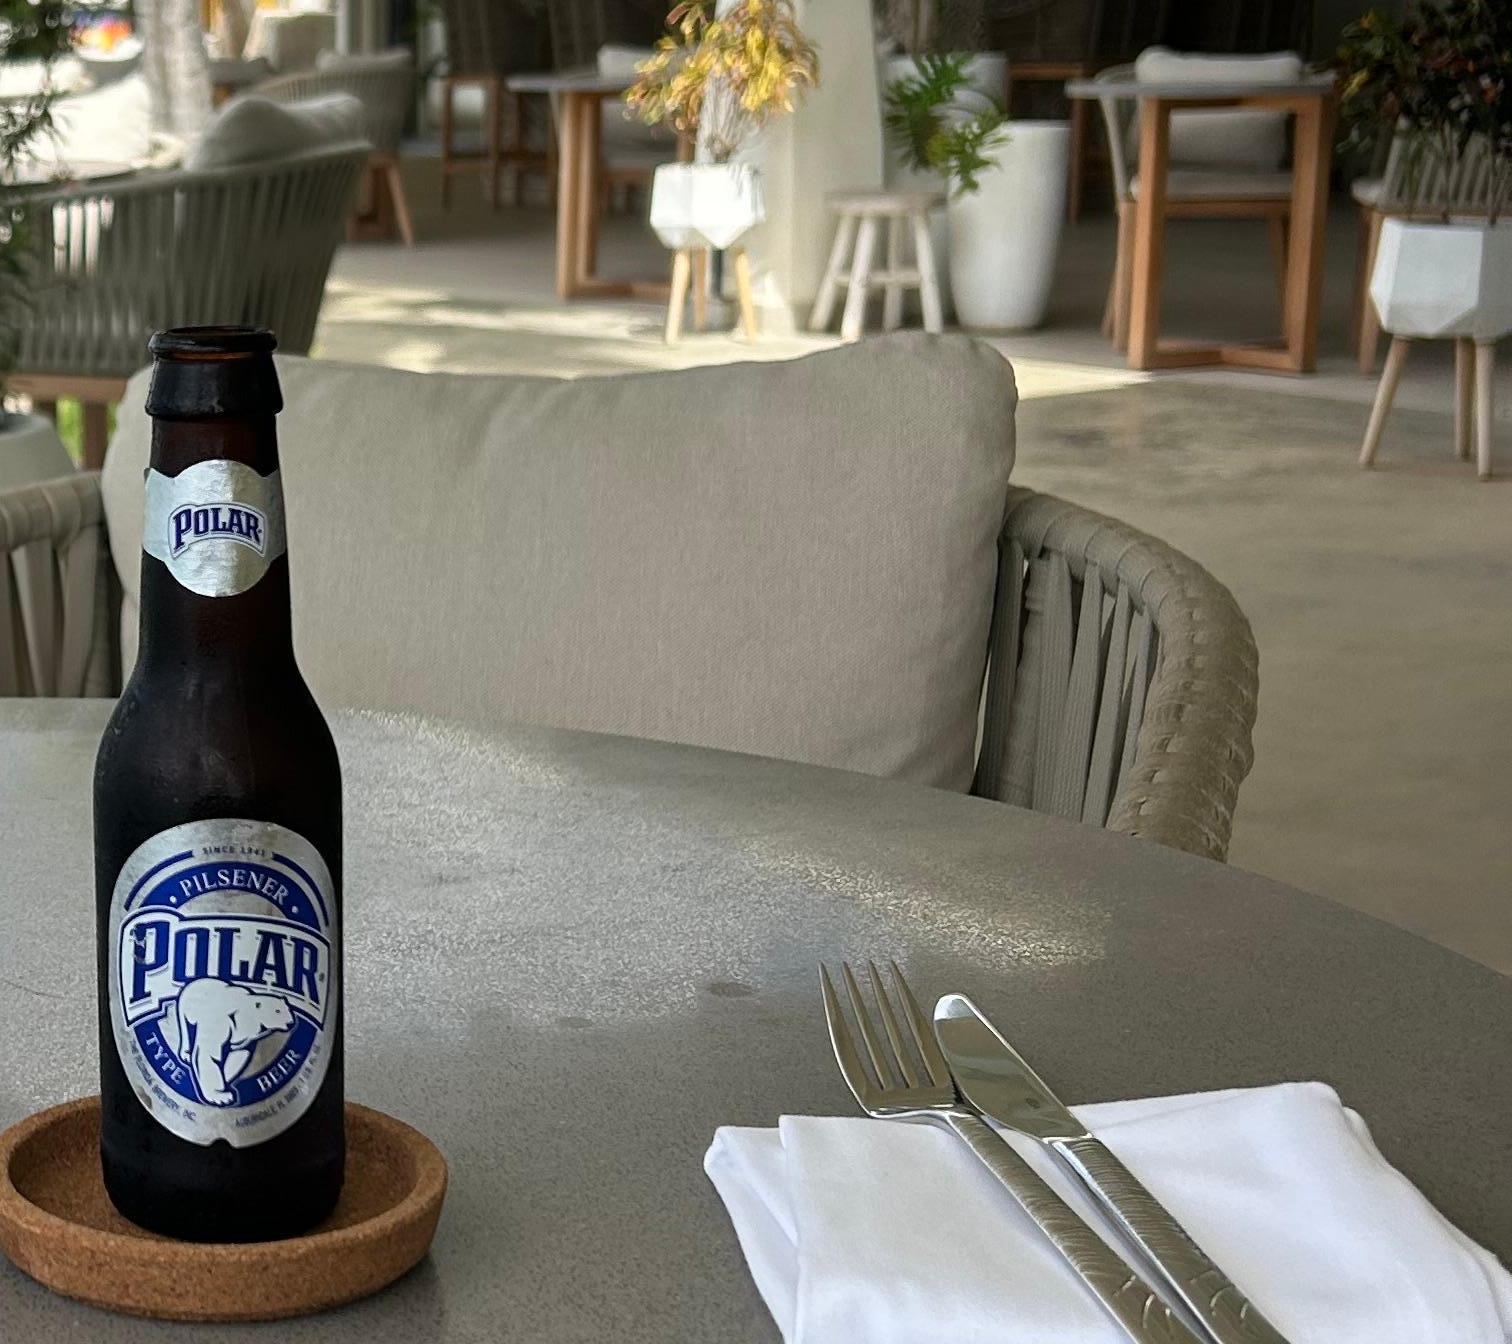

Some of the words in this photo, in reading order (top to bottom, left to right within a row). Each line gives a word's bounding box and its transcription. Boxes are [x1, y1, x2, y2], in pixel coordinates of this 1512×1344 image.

[172, 508, 261, 551] POLAR
[202, 845, 235, 855] SINCE
[179, 868, 289, 906] PILSENER
[129, 920, 320, 1005] POLAR
[145, 1031, 186, 1085] TYPE
[255, 1048, 301, 1093] BEER
